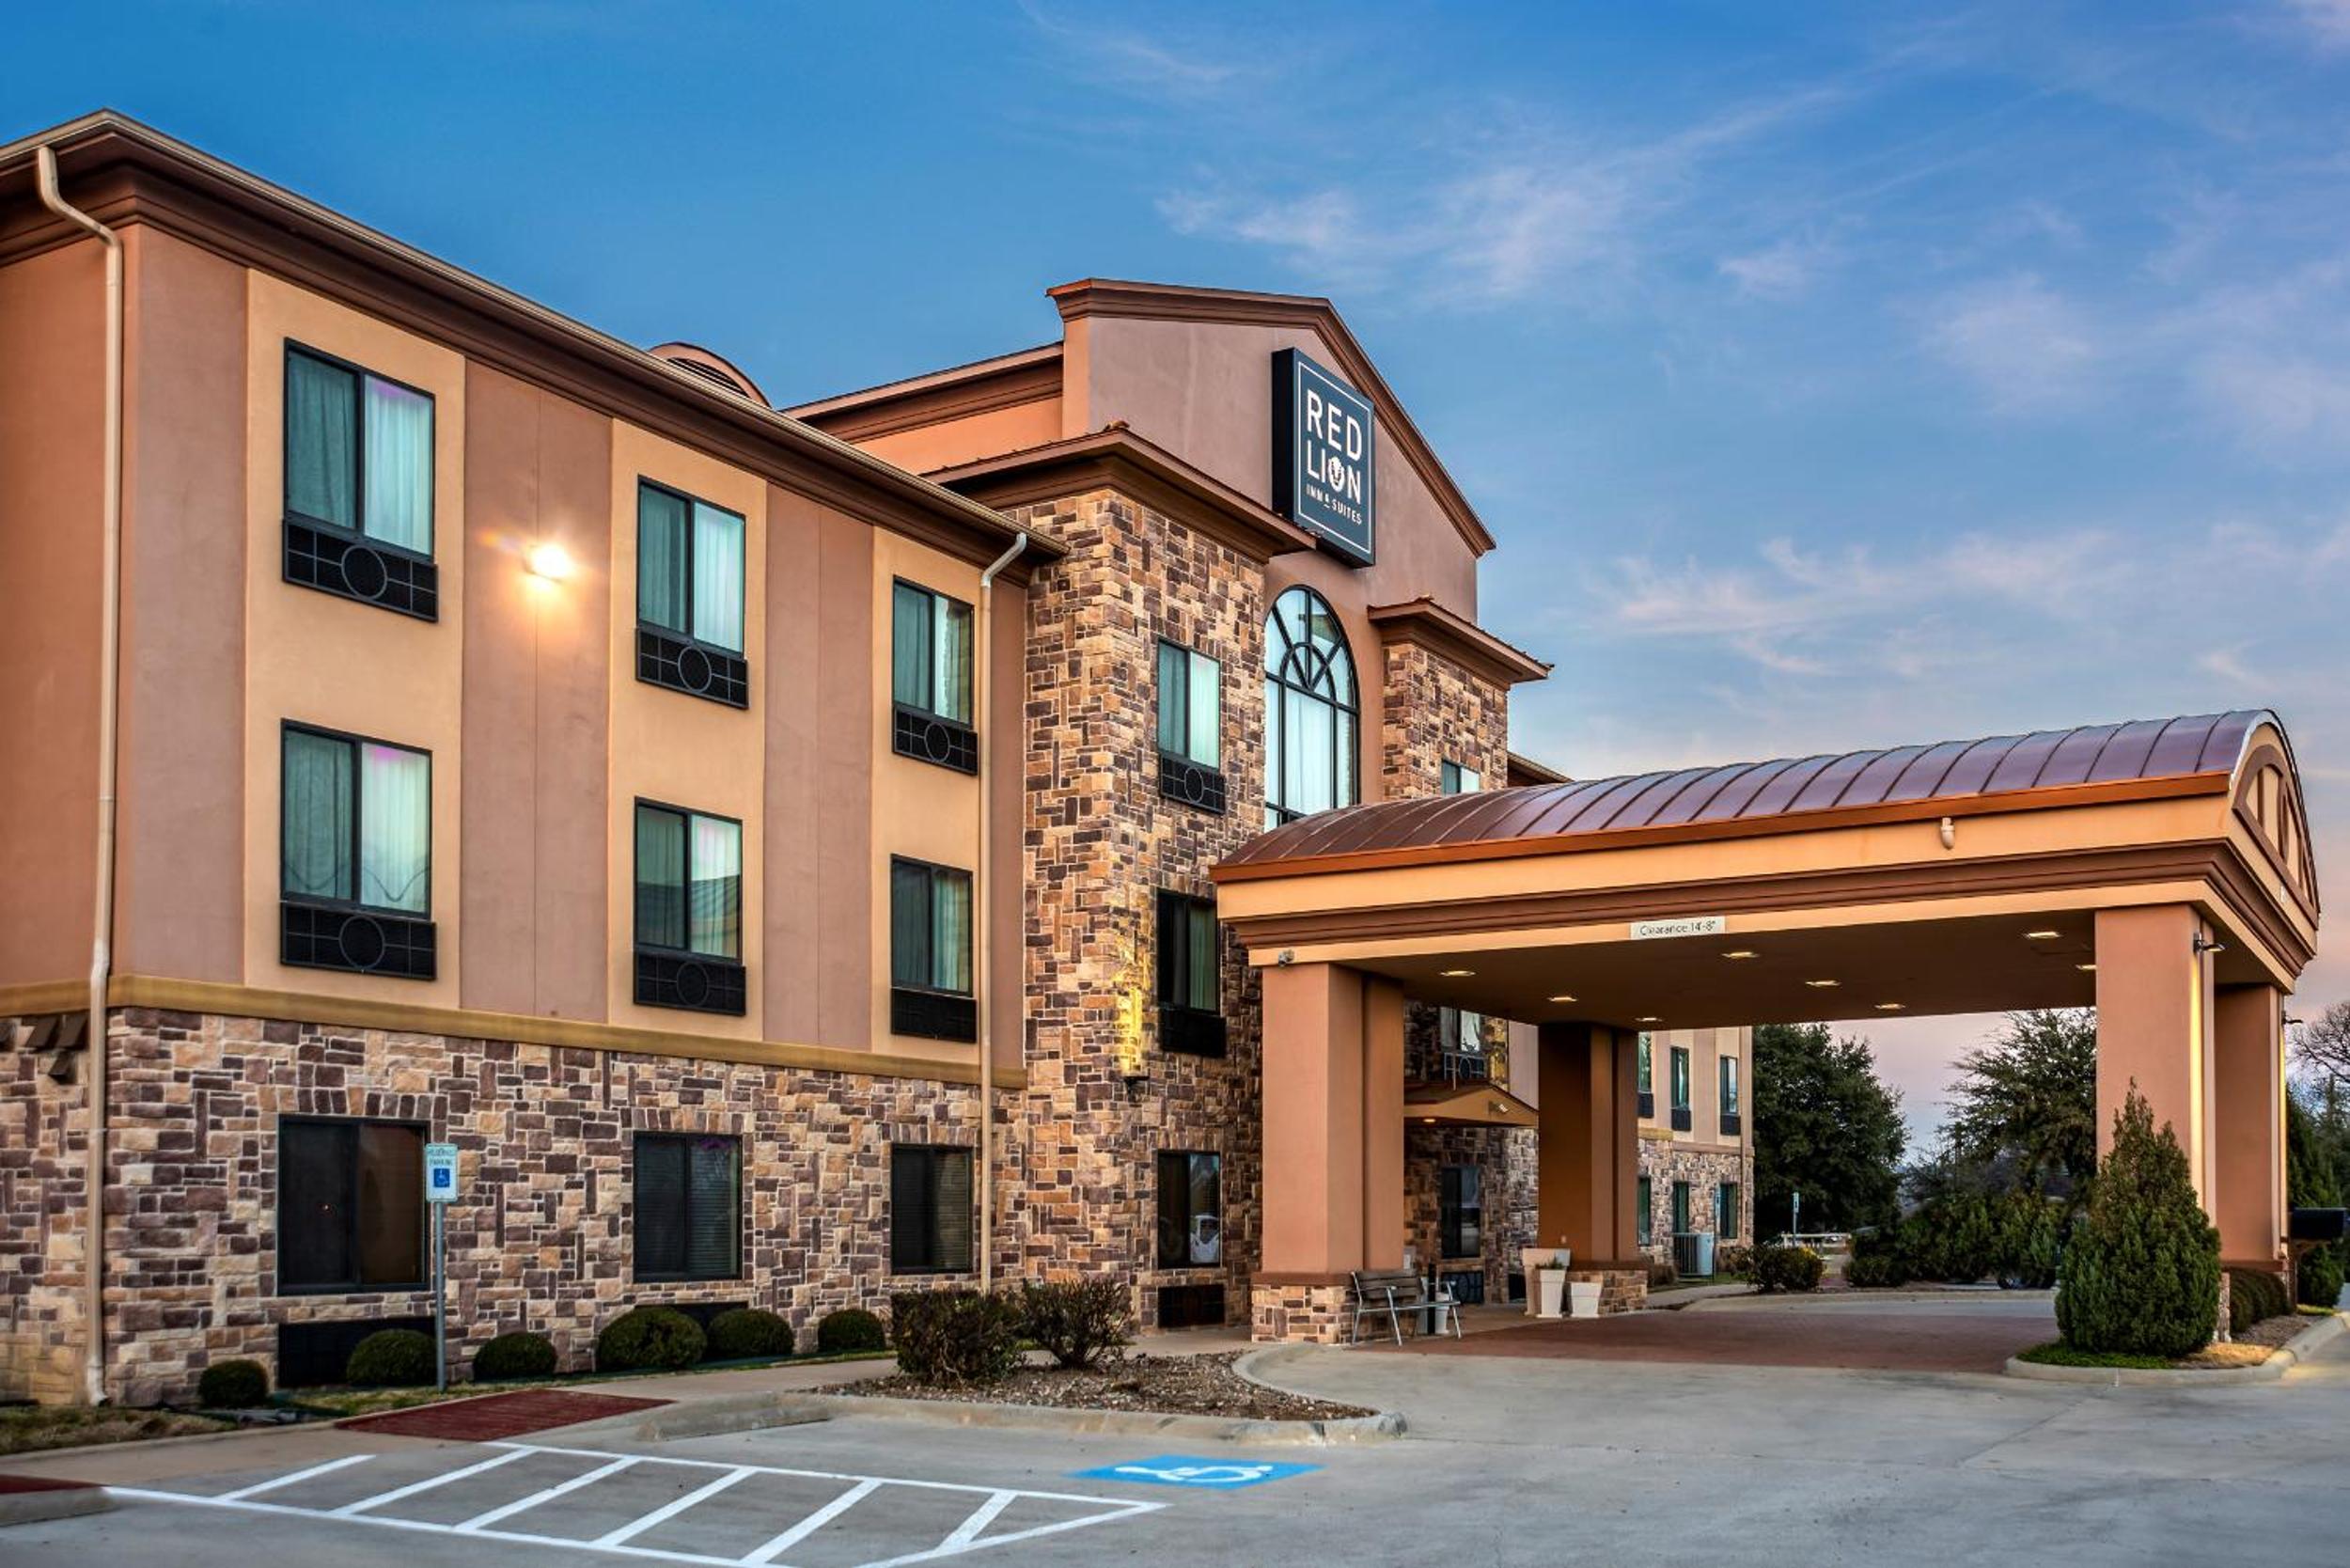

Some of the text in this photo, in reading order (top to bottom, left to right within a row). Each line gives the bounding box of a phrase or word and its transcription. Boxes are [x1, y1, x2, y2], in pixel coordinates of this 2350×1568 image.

[1307, 389, 1362, 462] RED
[1306, 484, 1324, 502] INN
[1332, 497, 1362, 525] SUITES
[1307, 440, 1362, 505] LION
